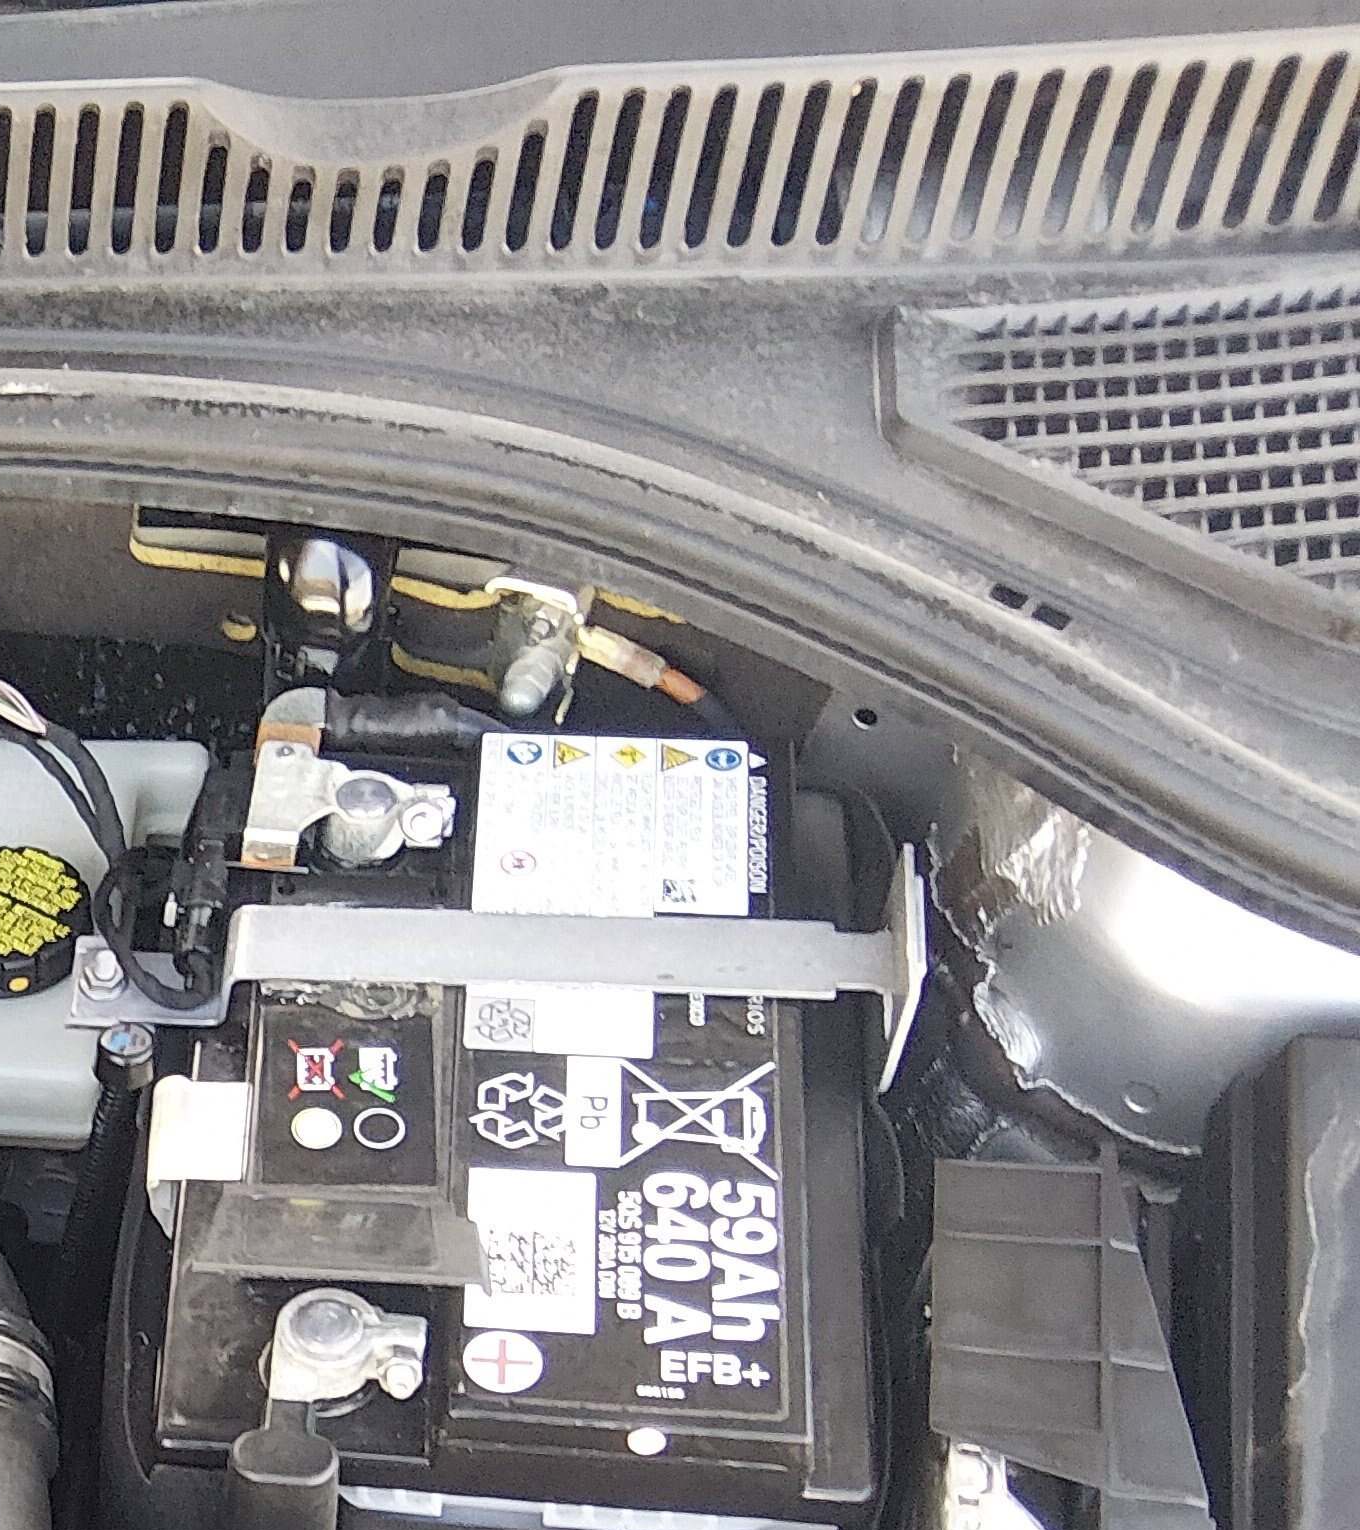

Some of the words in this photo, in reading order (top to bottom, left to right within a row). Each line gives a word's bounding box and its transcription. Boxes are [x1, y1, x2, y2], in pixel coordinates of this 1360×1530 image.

[747, 995, 766, 1035] RIOS
[580, 1096, 608, 1130] Pb
[642, 1172, 712, 1282] 640
[710, 1180, 780, 1343] 59Ah
[643, 1294, 712, 1345] A
[661, 1350, 771, 1388] EFB+
